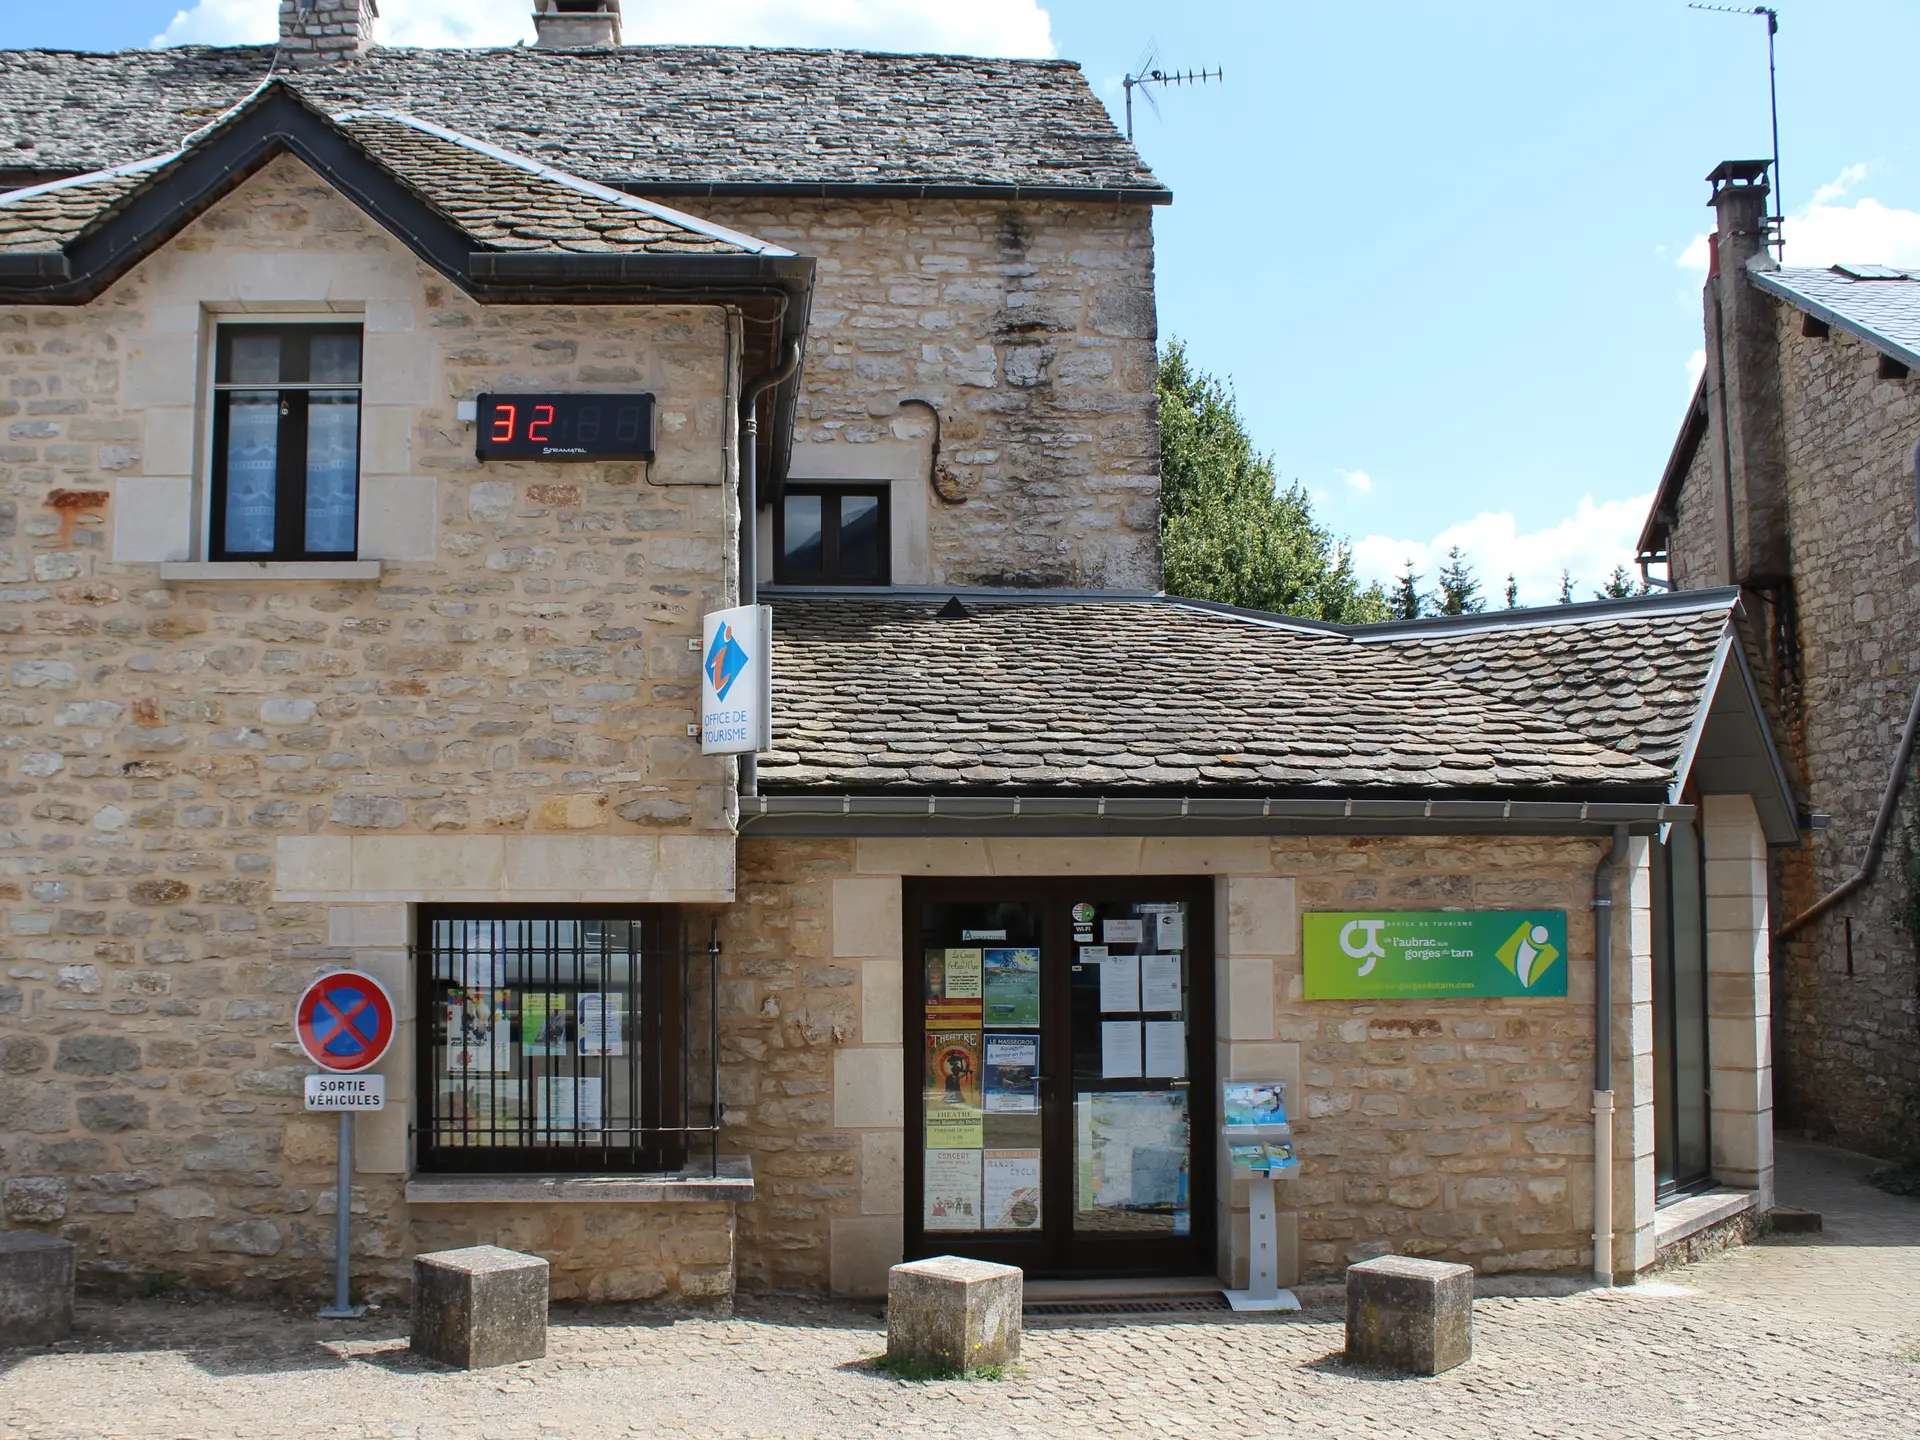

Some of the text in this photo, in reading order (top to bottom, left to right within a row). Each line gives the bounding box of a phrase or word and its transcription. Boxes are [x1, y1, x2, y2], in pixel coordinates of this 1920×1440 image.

[542, 447, 587, 455] STRAMATEL
[704, 710, 747, 727] OFFICE DE
[704, 727, 747, 743] TOURISME
[1393, 937, 1437, 947] l'aubrac
[1404, 949, 1441, 961] gorges
[1451, 949, 1474, 958] tarn
[938, 1152, 970, 1160] CONCERT
[1010, 1168, 1037, 1176] CYCLO
